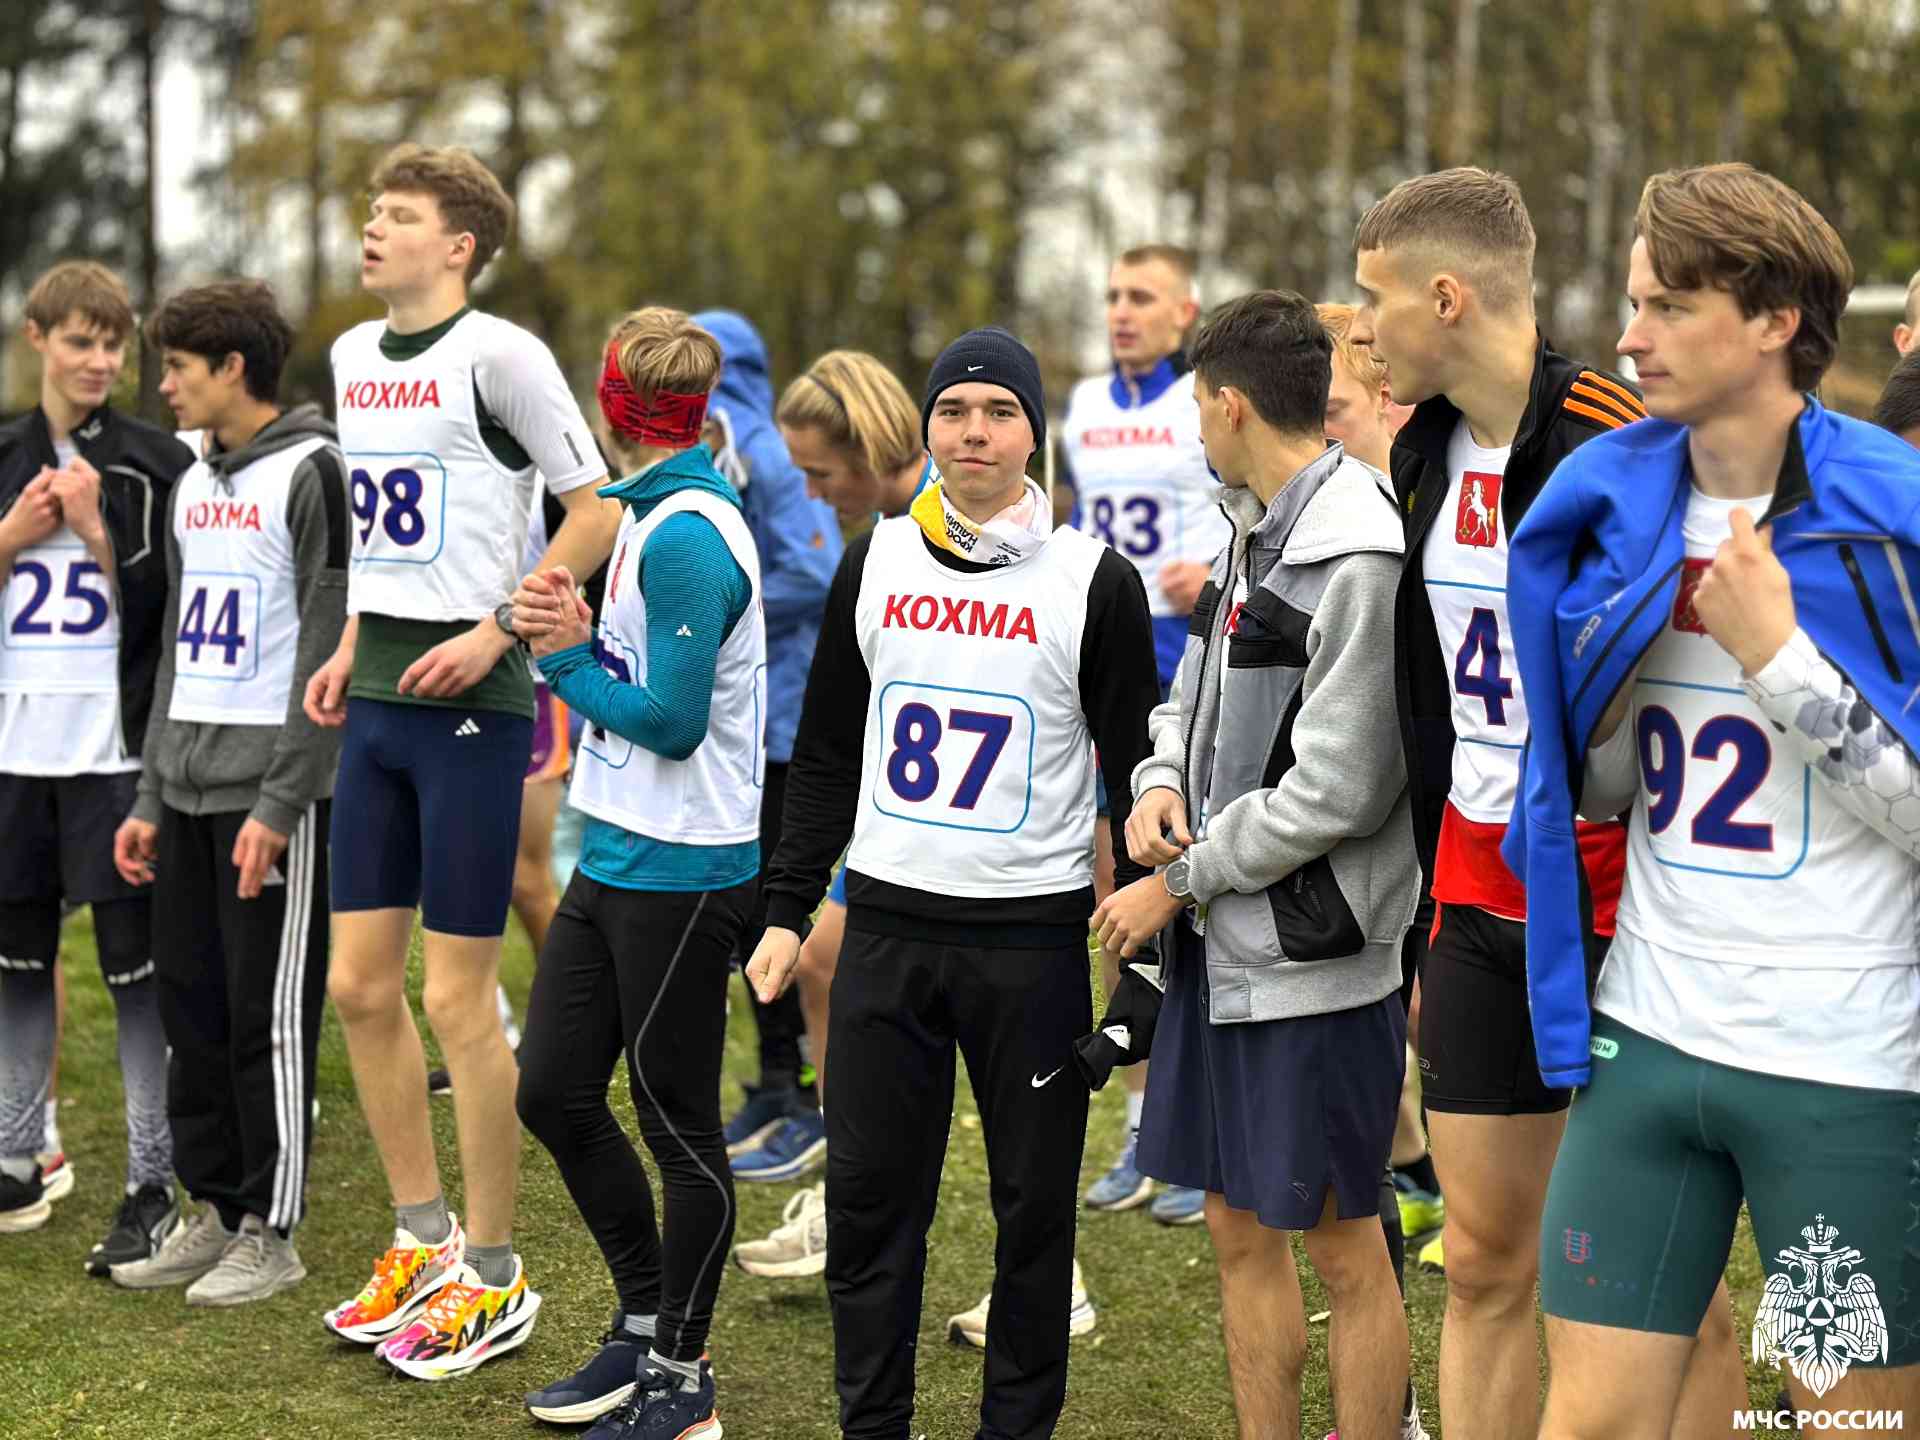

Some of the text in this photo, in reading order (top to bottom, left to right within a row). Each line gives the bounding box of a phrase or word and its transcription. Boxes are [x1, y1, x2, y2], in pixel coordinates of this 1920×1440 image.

[343, 379, 441, 409] КОХМА
[350, 467, 426, 547] 98
[1094, 495, 1162, 557] 83
[11, 561, 109, 635] 25
[177, 586, 246, 666] 44
[882, 594, 1039, 645] КОХМА
[1455, 606, 1514, 726] 4
[886, 701, 1013, 811] 87
[1637, 704, 1775, 853] 92
